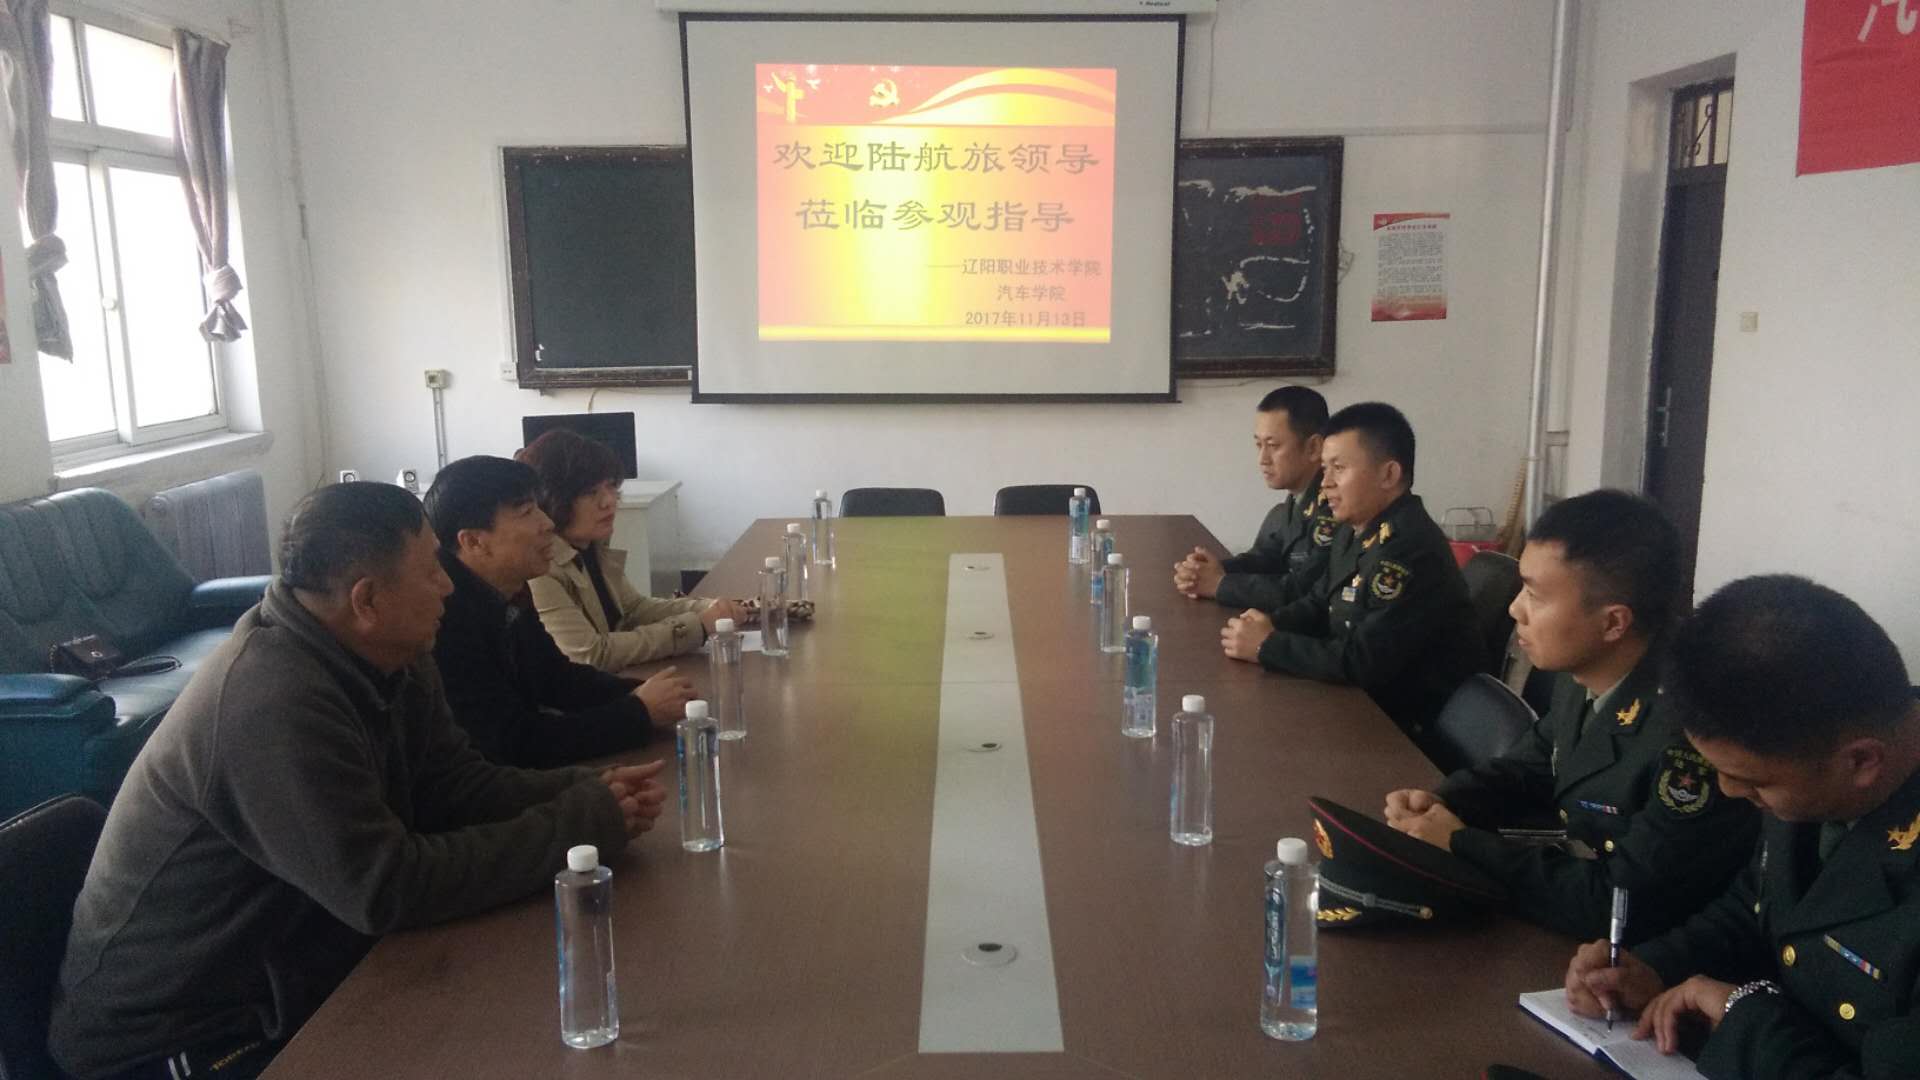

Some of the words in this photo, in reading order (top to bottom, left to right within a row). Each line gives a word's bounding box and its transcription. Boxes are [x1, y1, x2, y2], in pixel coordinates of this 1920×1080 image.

[773, 141, 1100, 175] 欢迎陆航旅领导
[795, 199, 1075, 233] 莅临参观指导
[997, 285, 1066, 302] 汽车学院
[965, 310, 1086, 327] 2017年11月13日
